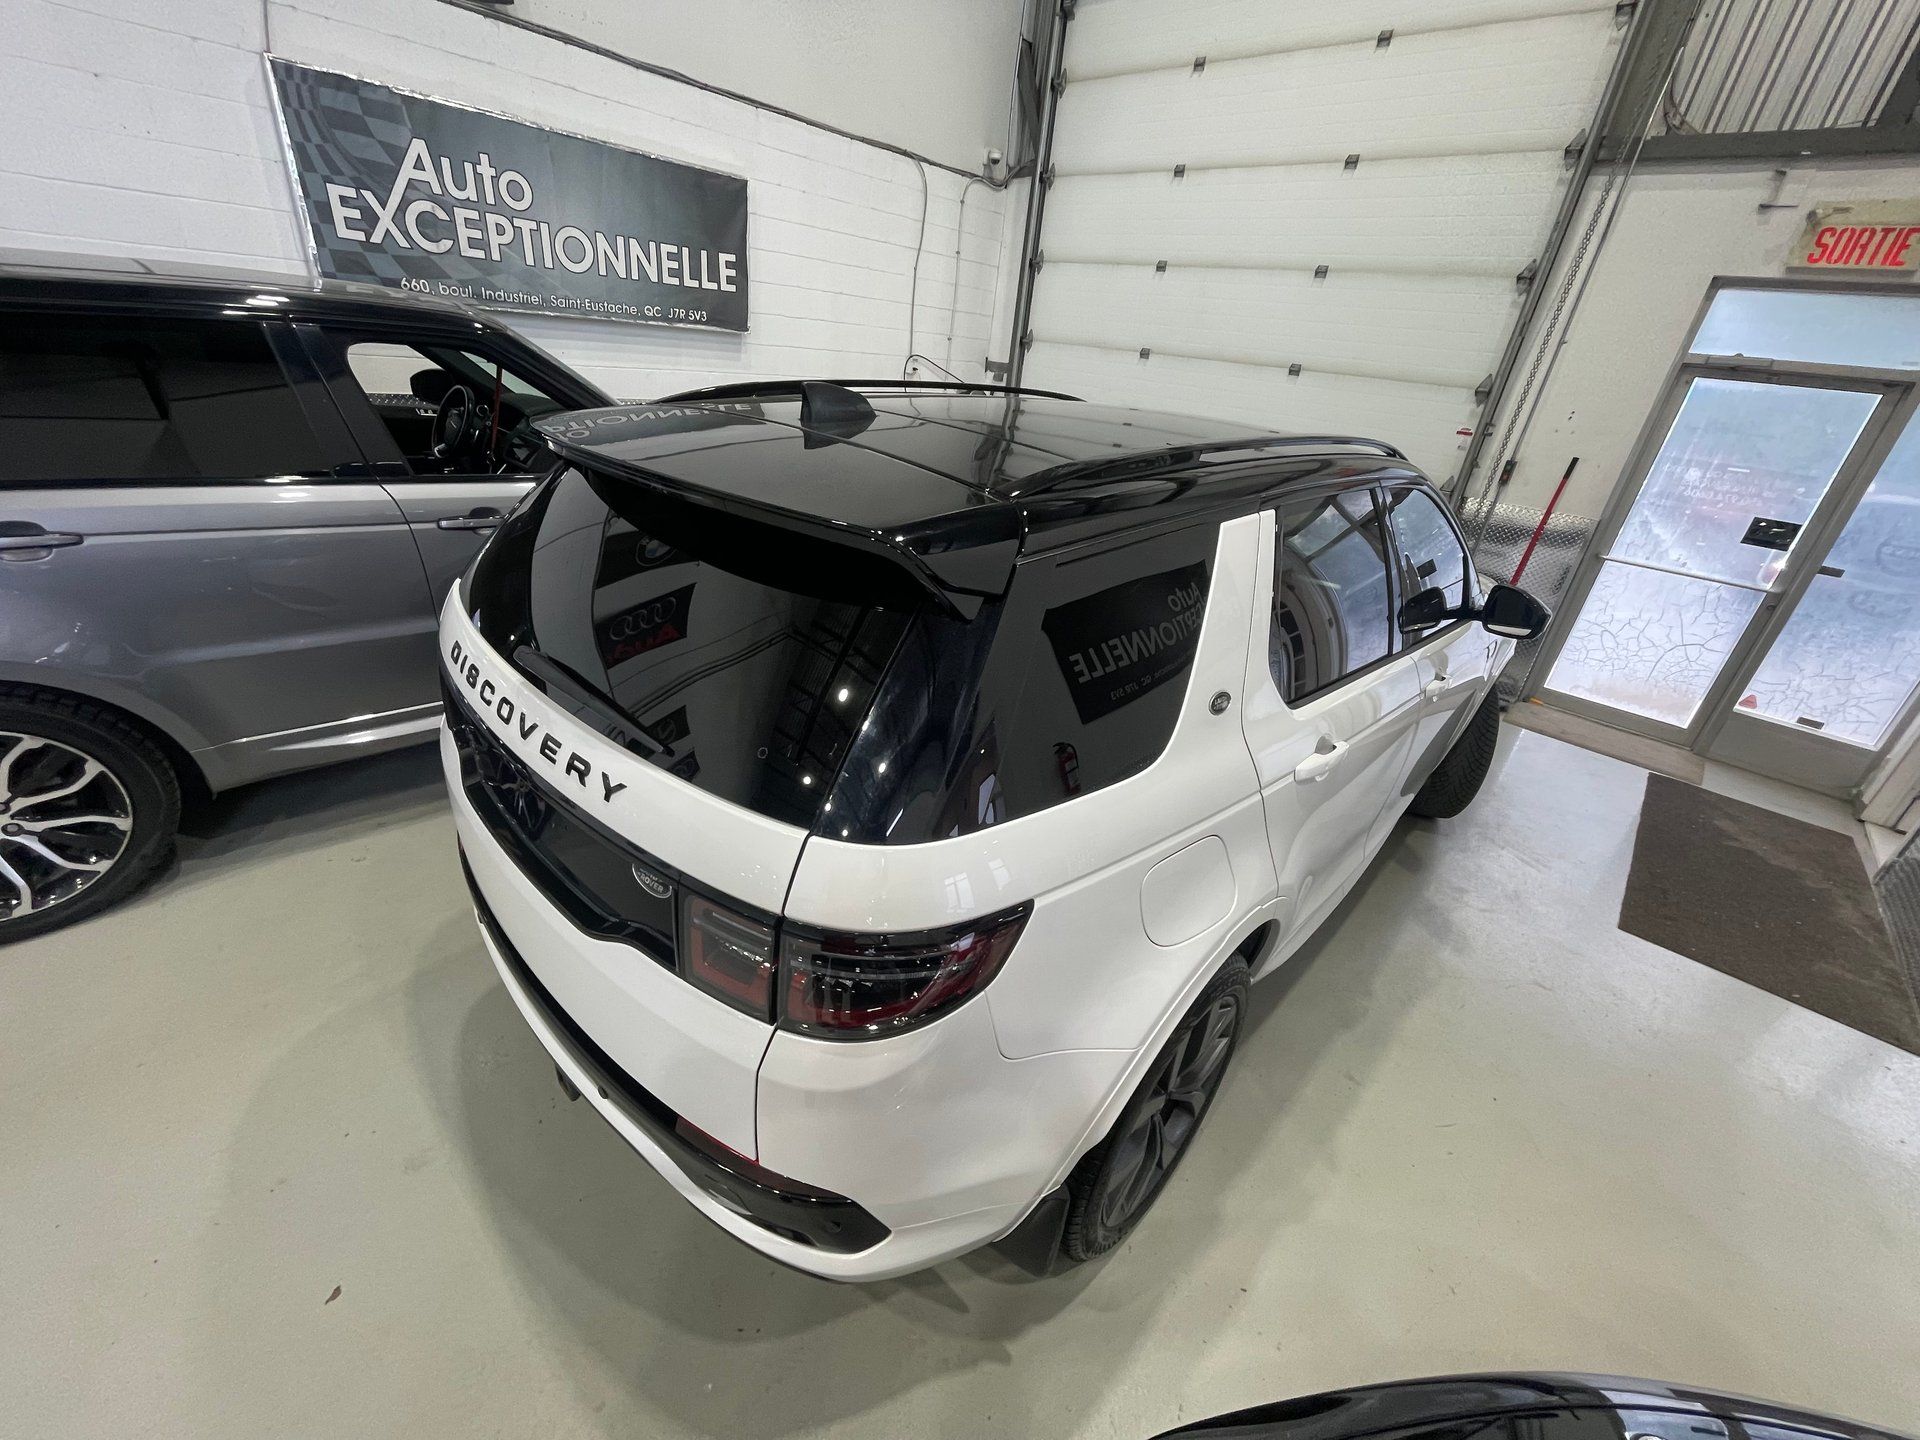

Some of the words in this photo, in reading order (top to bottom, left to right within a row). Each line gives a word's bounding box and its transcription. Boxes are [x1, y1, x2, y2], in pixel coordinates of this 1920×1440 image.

[396, 137, 534, 213] Auto
[325, 182, 738, 293] EXCEPTIONNELLE
[1806, 226, 1920, 267] SORTIE
[400, 276, 436, 296] 660,
[438, 281, 478, 299] boul.
[481, 286, 547, 308] Industriel,
[550, 294, 642, 317] Saint-Eustache,
[644, 304, 662, 318] QC
[667, 307, 686, 320] J7R
[688, 309, 708, 322] 5V3
[450, 639, 628, 803] DISCOVERY
